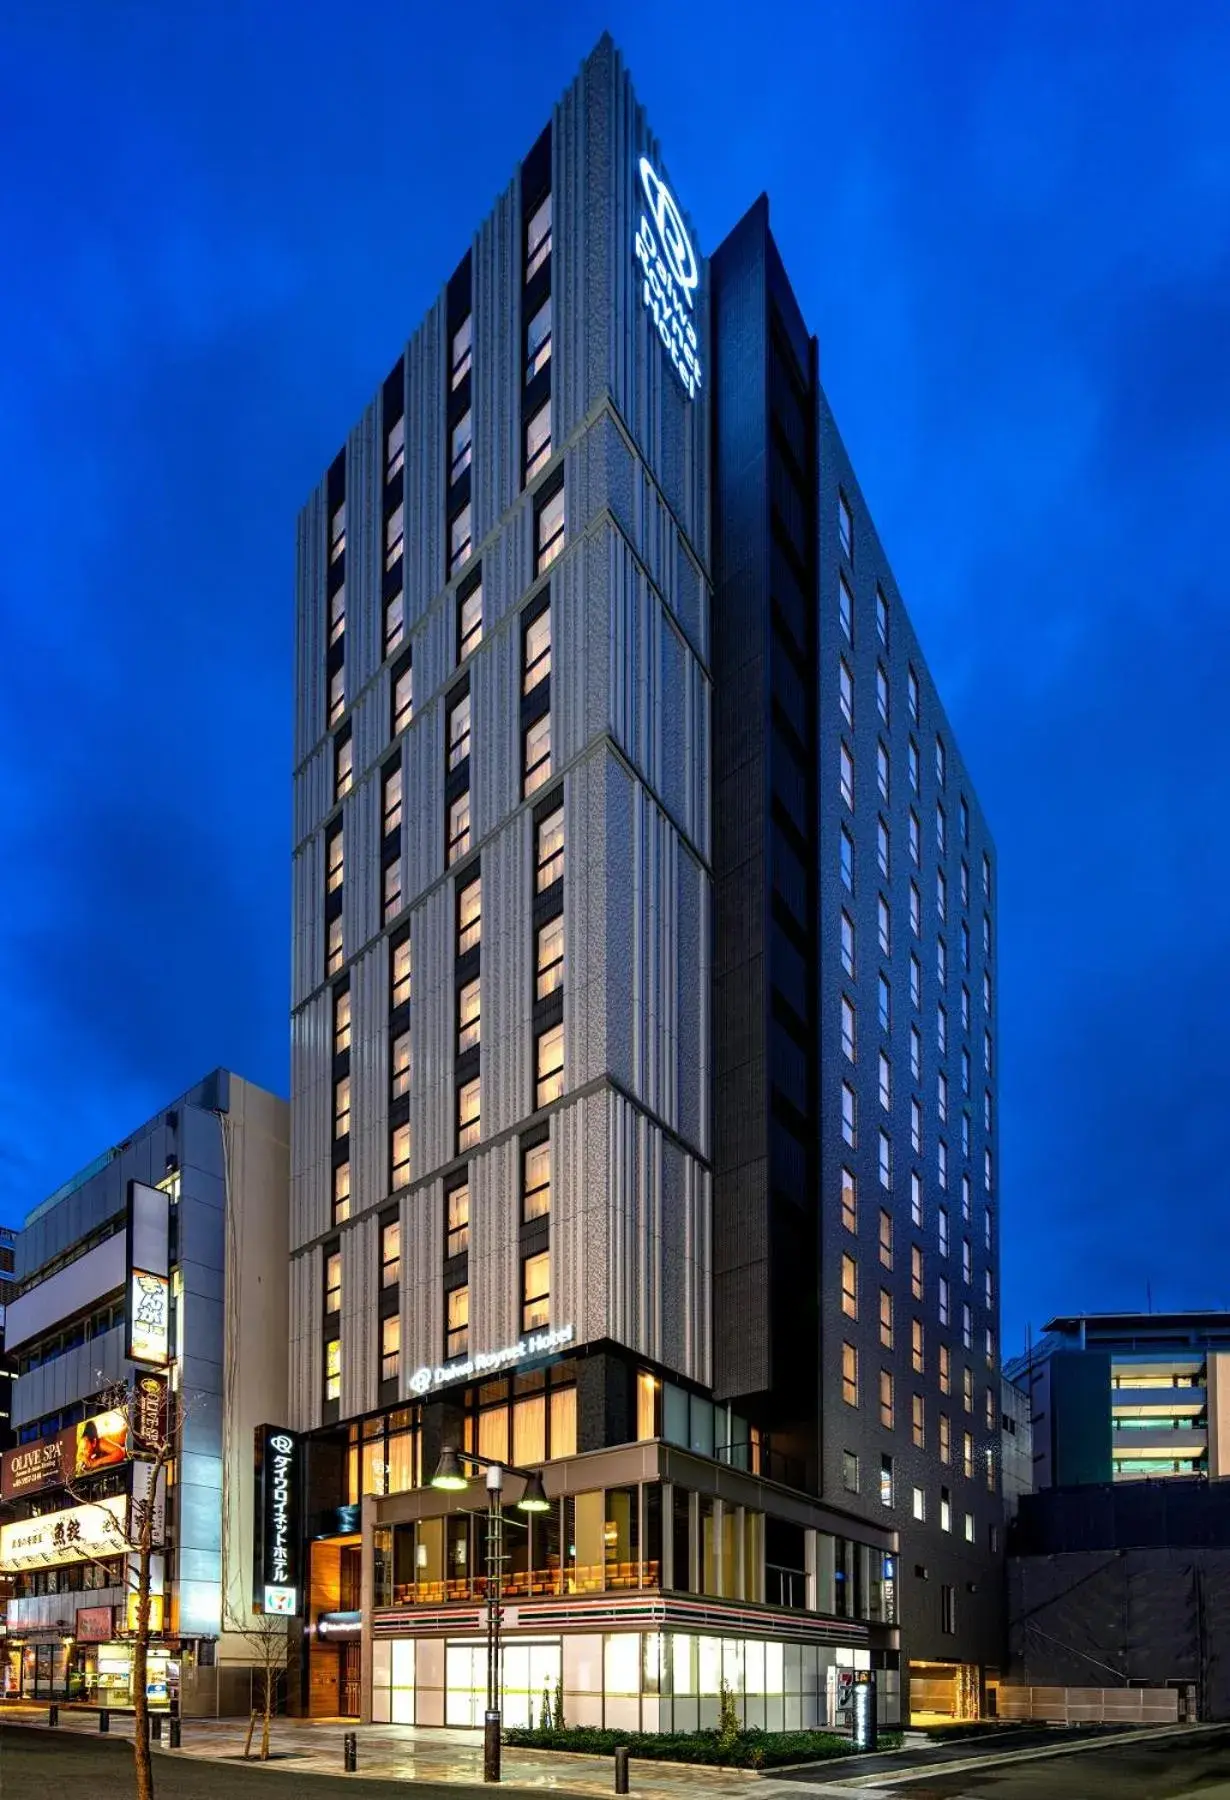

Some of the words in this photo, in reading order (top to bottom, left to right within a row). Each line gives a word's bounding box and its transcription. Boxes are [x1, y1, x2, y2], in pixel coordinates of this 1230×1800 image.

[529, 1325, 573, 1353] Hotel
[11, 1449, 41, 1473] OLIVE
[43, 1442, 62, 1461] SPA
[273, 1456, 293, 1582] ダイワロイネットホテル
